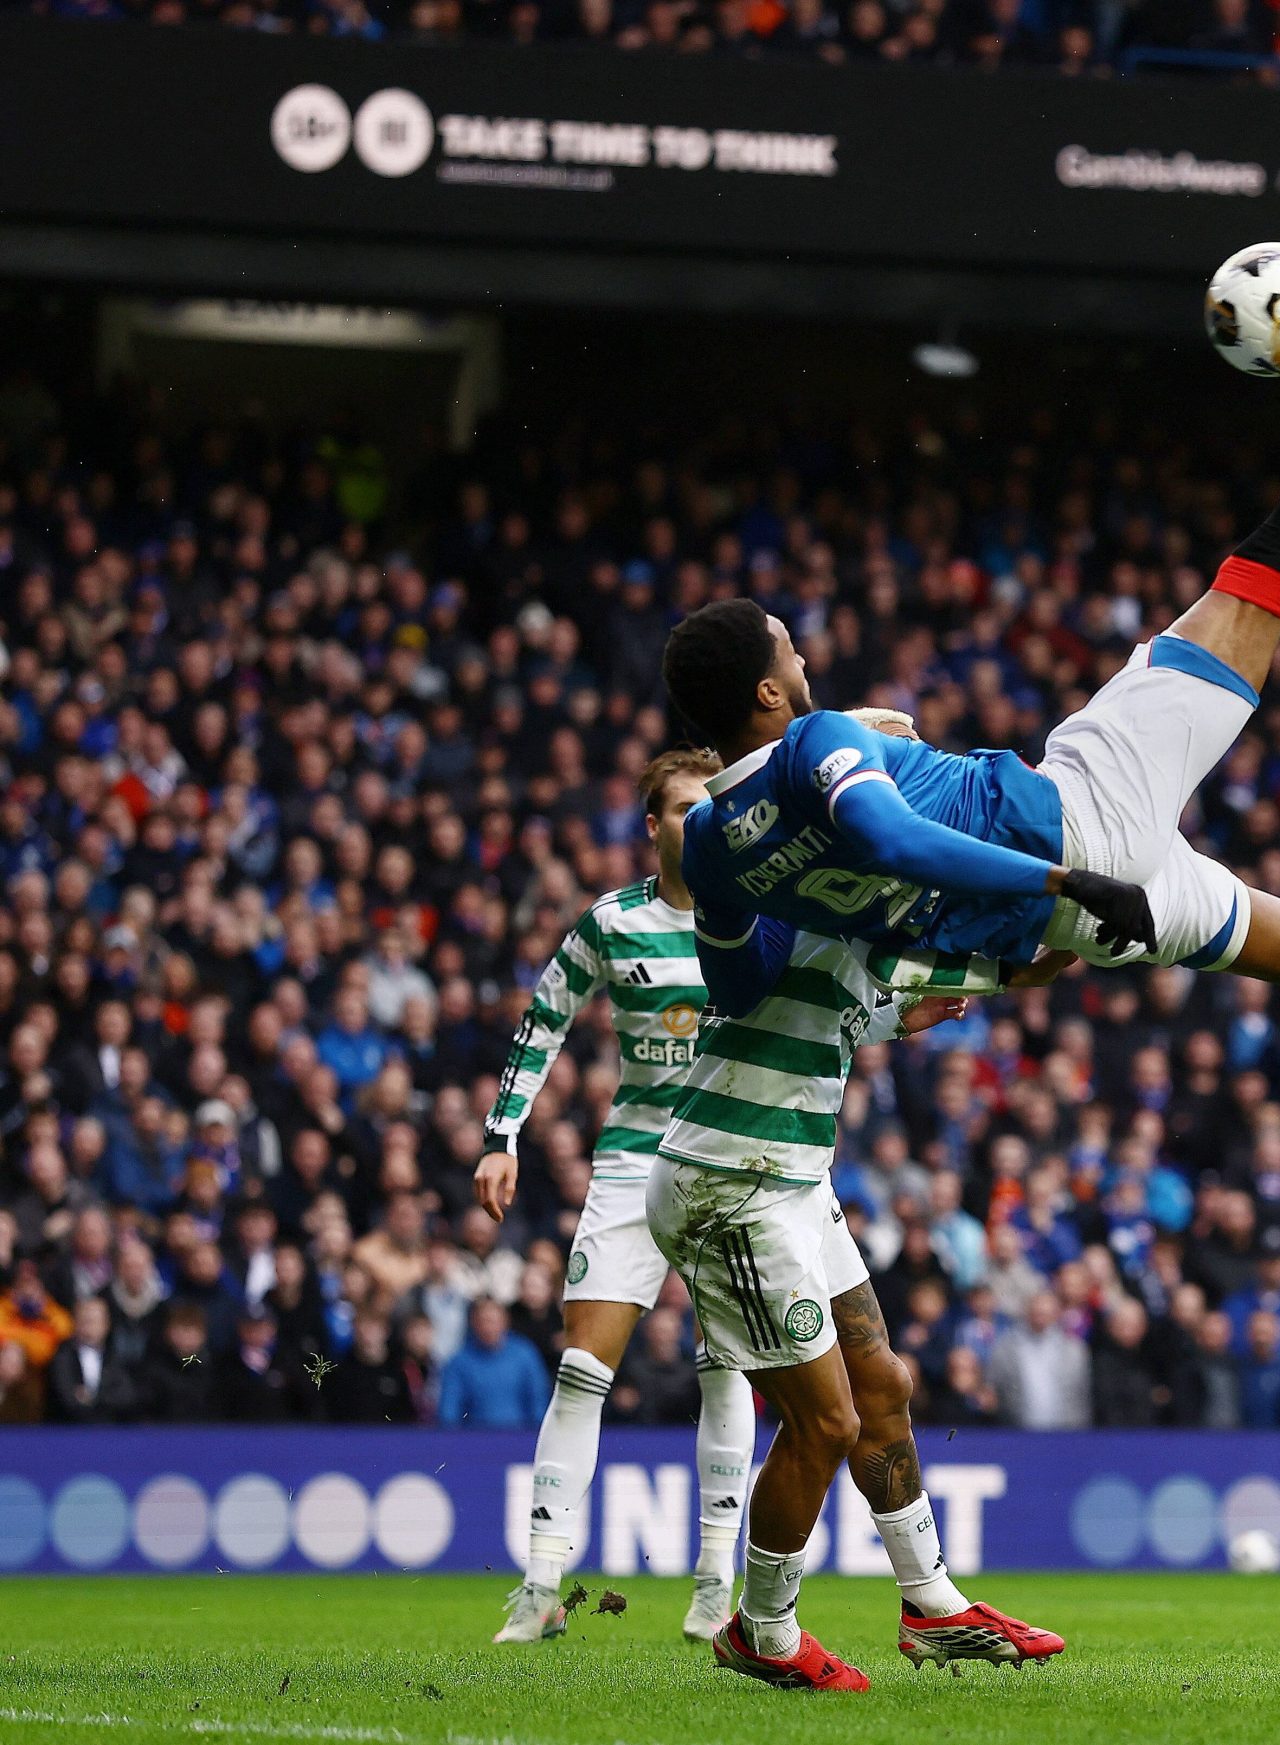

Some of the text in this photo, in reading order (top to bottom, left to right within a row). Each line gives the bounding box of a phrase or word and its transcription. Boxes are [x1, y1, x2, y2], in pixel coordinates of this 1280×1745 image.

[438, 114, 838, 178] TAKE TIME TO THINK
[721, 799, 780, 850] EKO
